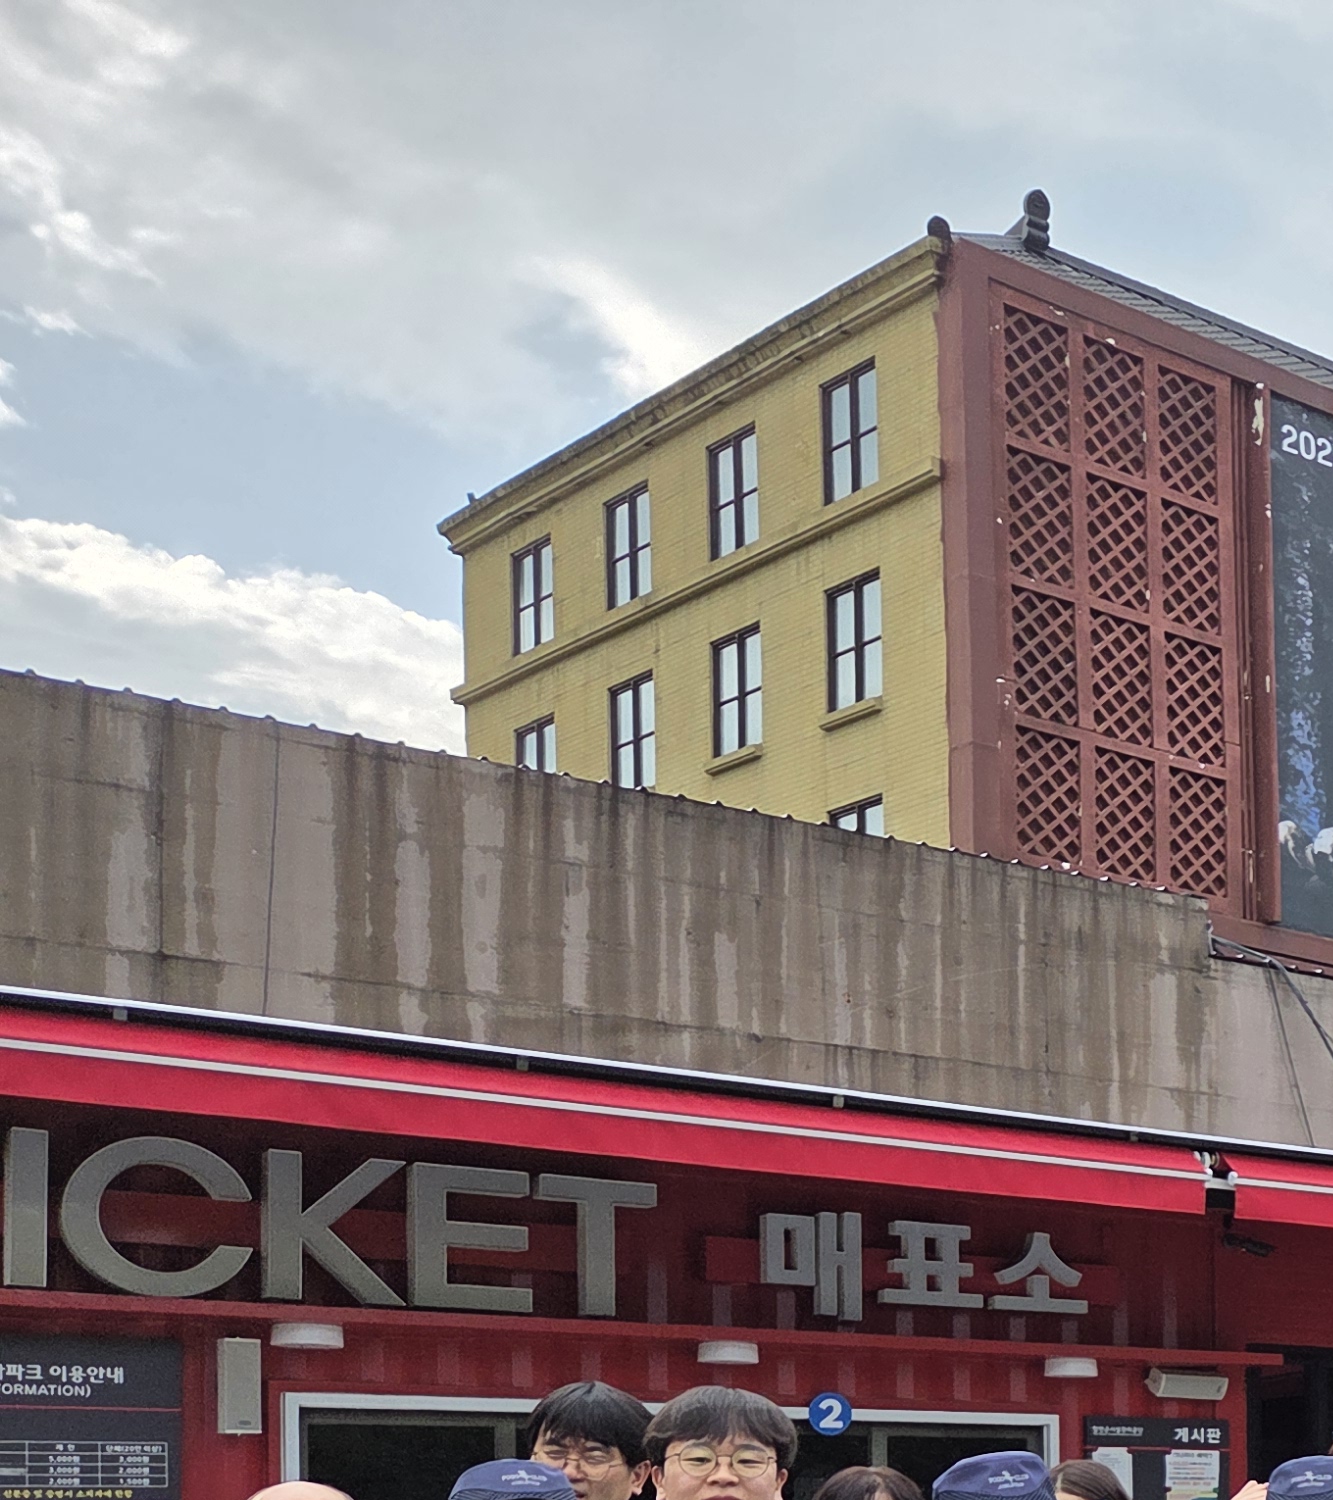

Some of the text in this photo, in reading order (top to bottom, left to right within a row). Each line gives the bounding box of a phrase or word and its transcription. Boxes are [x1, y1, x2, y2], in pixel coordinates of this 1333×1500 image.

[759, 1210, 1089, 1322] 매표소
[0, 1363, 125, 1385] 파크 이용안내
[0, 1382, 92, 1398] ORMATION)
[818, 1397, 844, 1429] 2
[1173, 1427, 1222, 1444] 게시판
